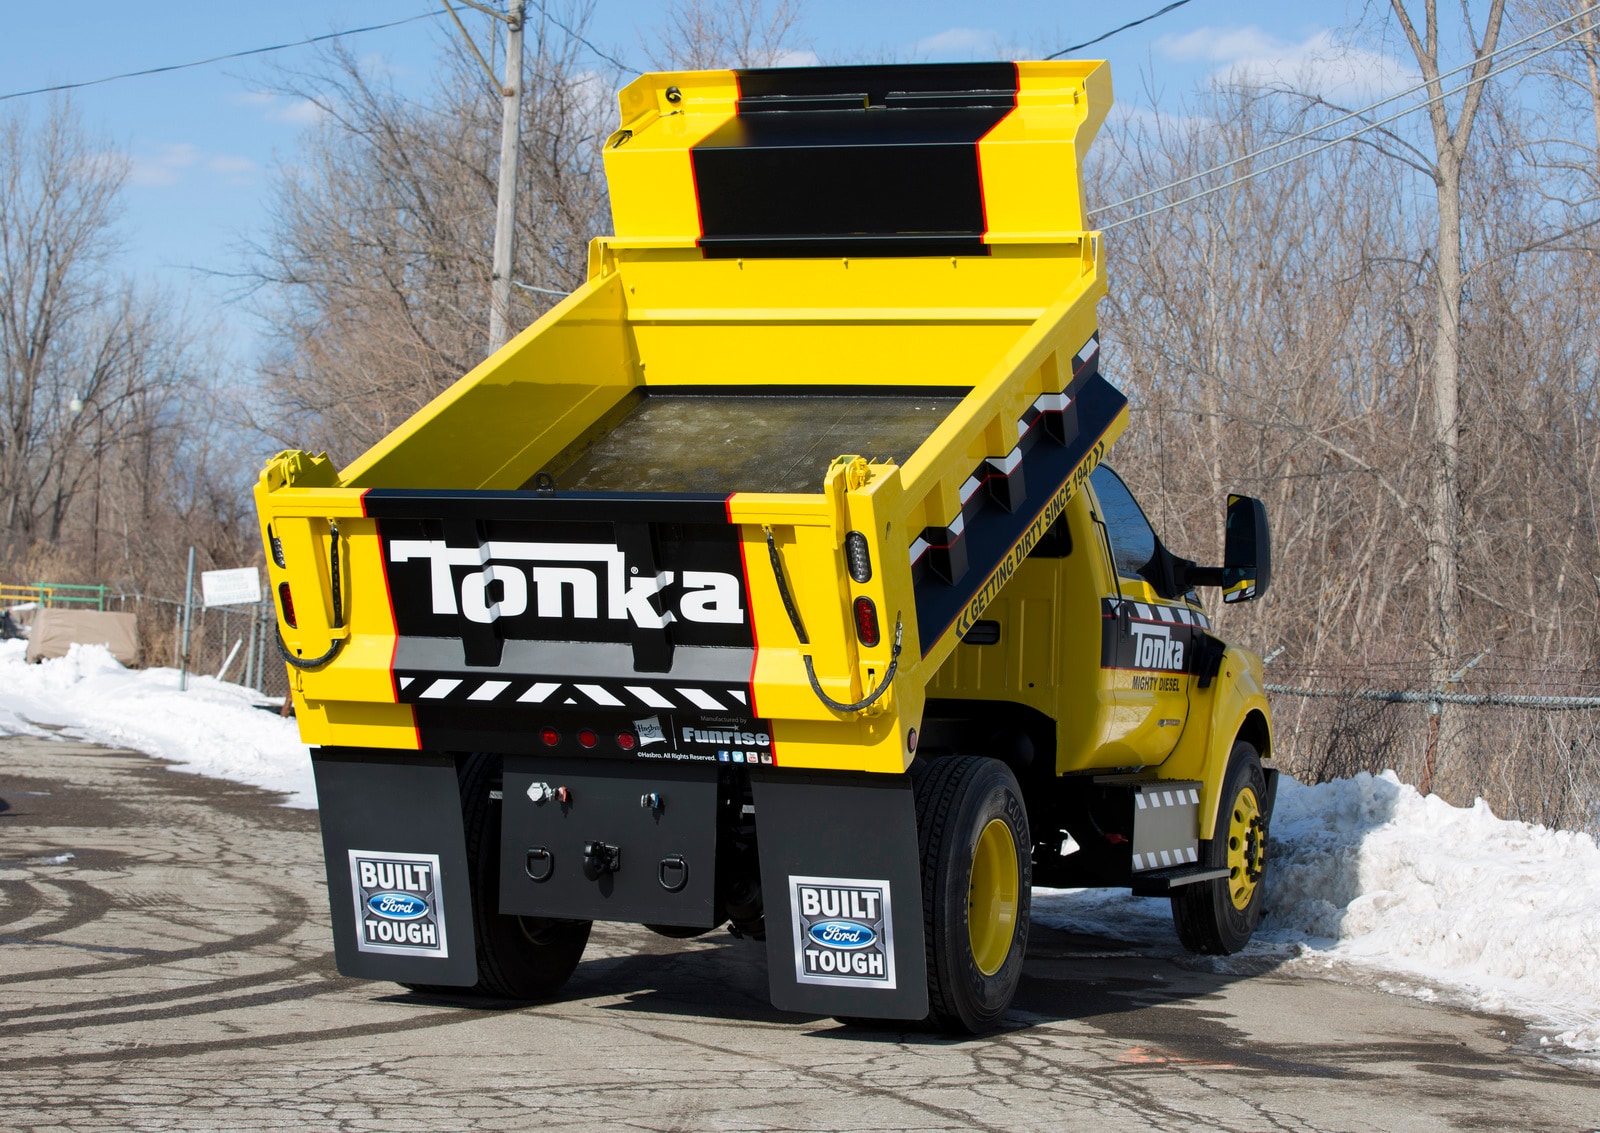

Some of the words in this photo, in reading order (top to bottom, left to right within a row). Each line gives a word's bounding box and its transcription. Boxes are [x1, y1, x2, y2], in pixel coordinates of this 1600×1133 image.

[971, 554, 1014, 619] GETTING
[1015, 518, 1042, 564] DIRTY
[1045, 483, 1072, 527] SINCE
[1073, 457, 1092, 490] 1947
[1131, 622, 1184, 670] Tonka
[1132, 676, 1158, 691] MIGHTY
[1159, 677, 1180, 692] DIESEL
[700, 715, 738, 723] Manufactured
[682, 727, 770, 746] Funrise
[360, 861, 430, 891] BUILT
[380, 896, 414, 914] Ford
[801, 888, 879, 919] BUILT
[365, 920, 436, 945] TOUGH
[822, 924, 860, 943] Ford
[806, 949, 884, 975] TOUGH
